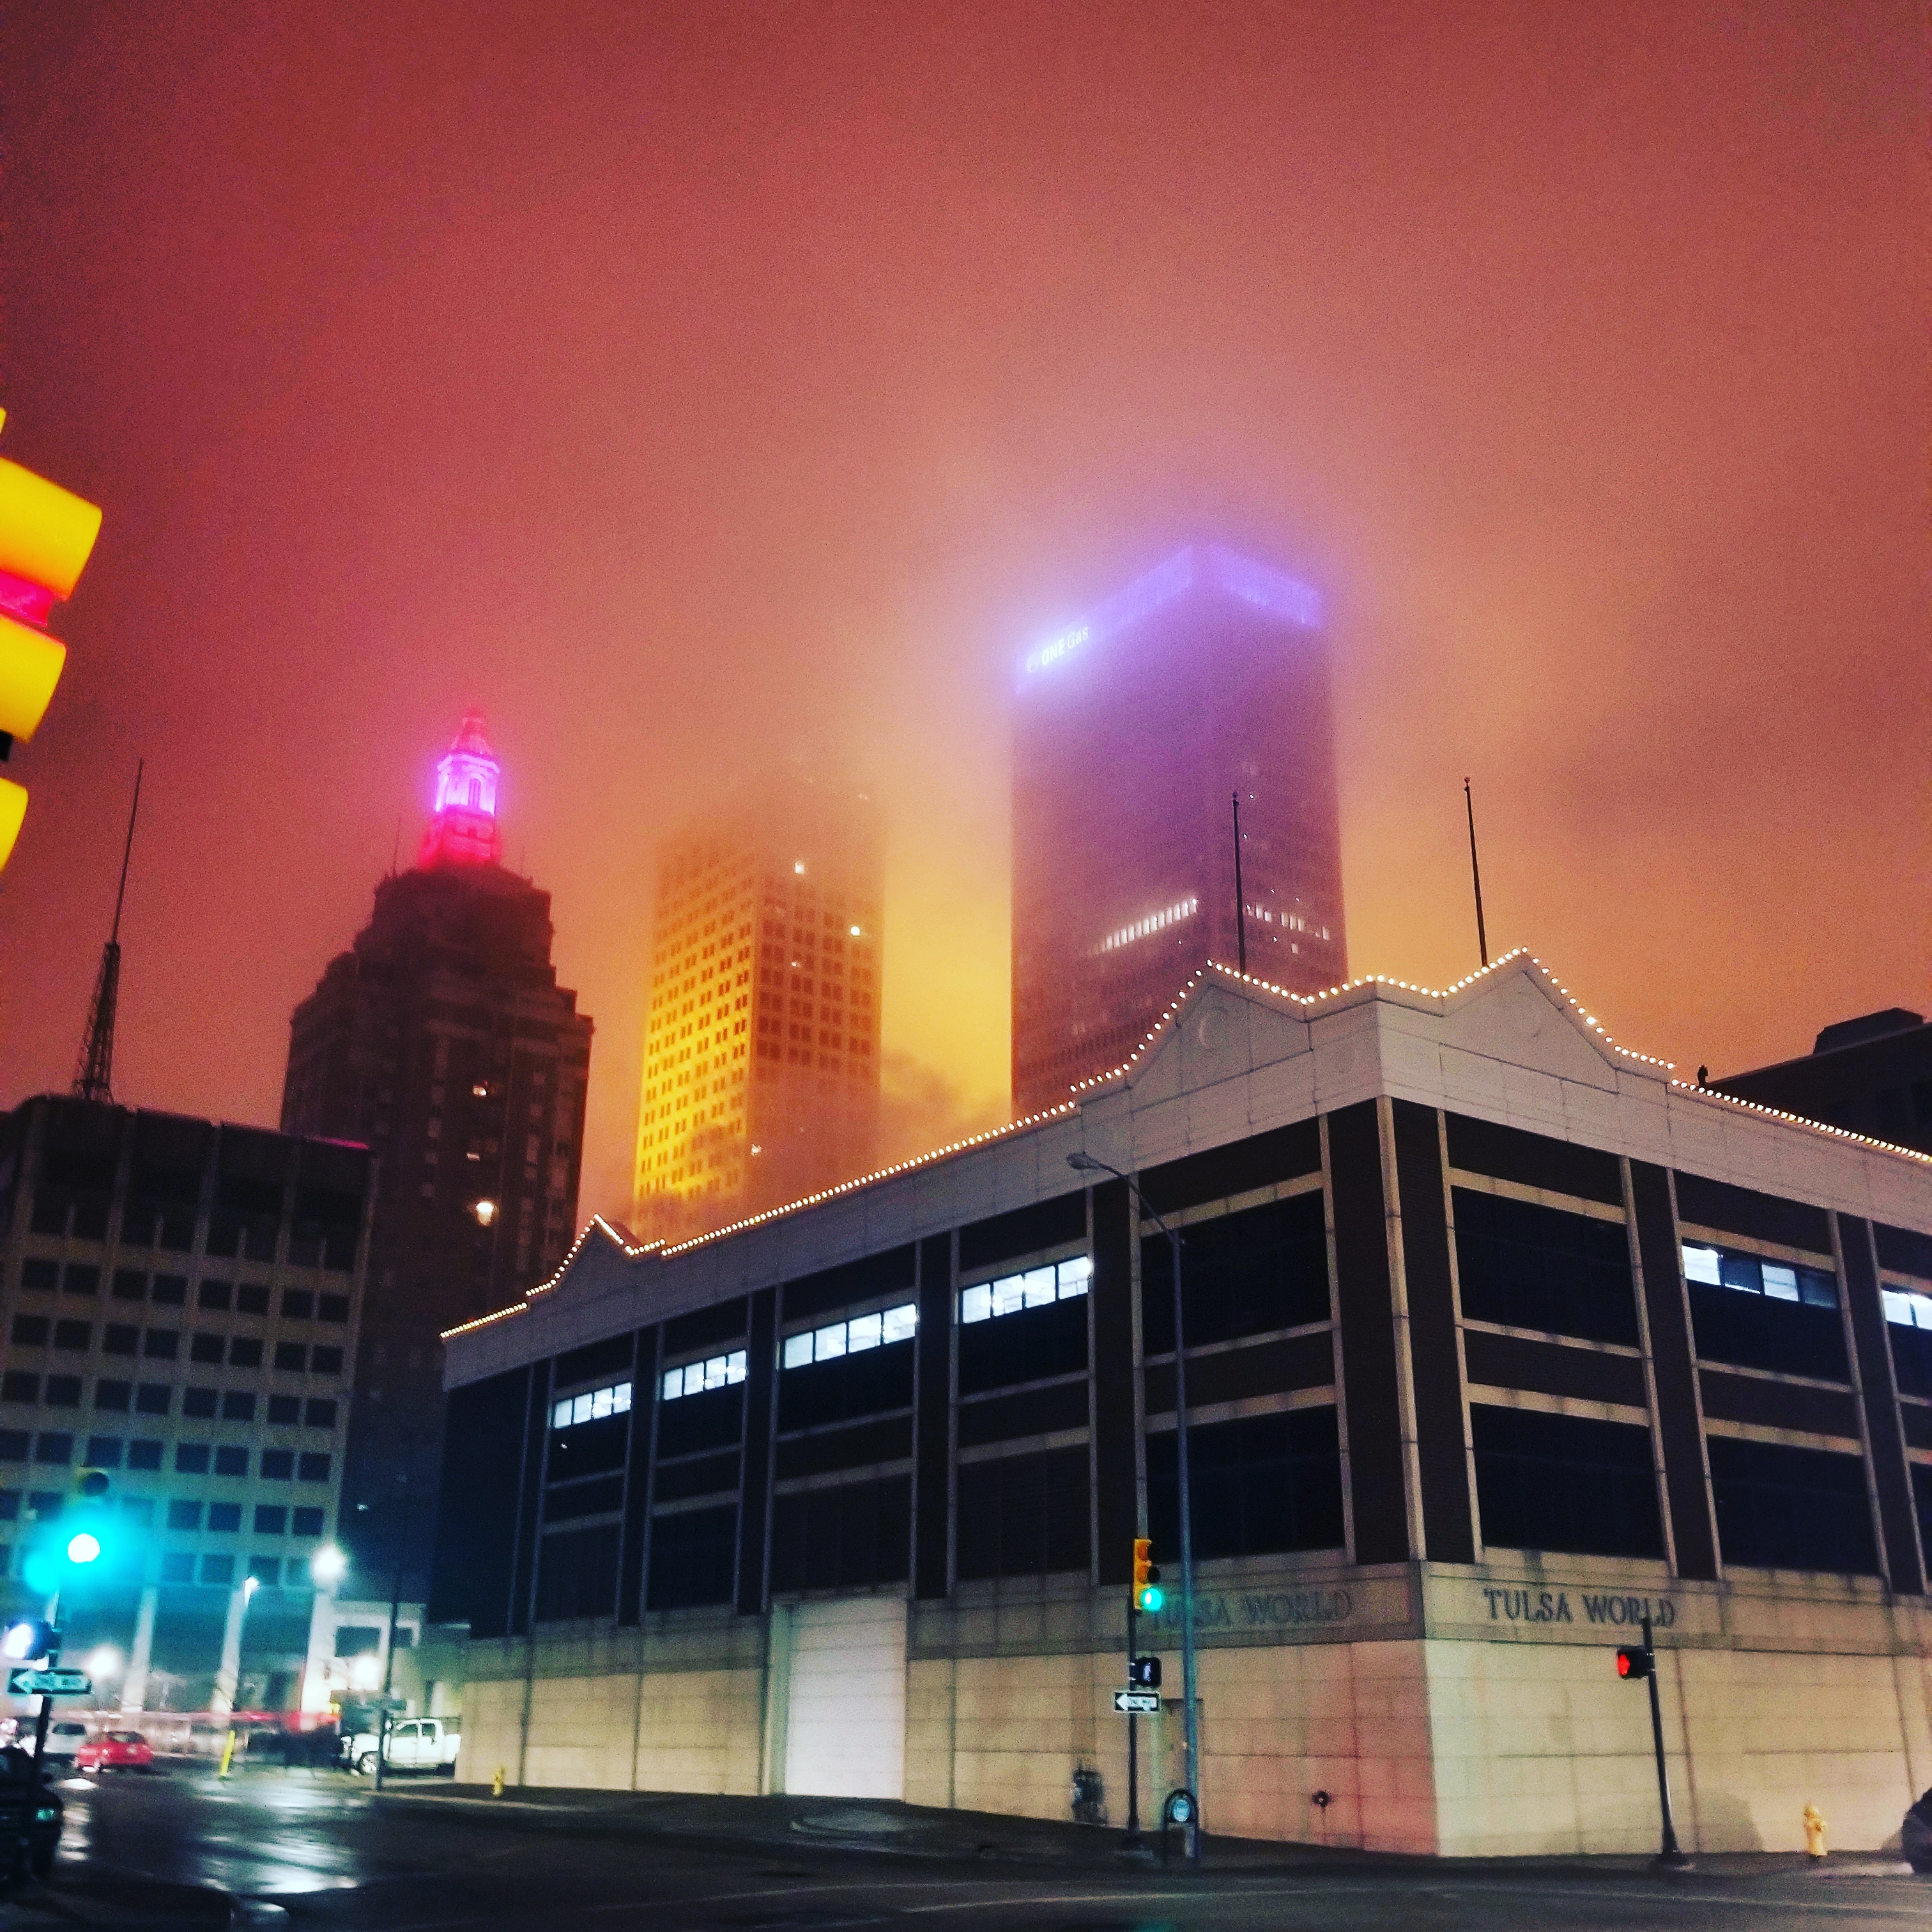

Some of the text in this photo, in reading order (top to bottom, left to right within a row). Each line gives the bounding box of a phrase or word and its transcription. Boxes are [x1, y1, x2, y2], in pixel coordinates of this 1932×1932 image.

[1041, 638, 1065, 666] ONE
[1243, 1590, 1352, 1625] WORLD
[1483, 1588, 1675, 1627] TULSA WORLD
